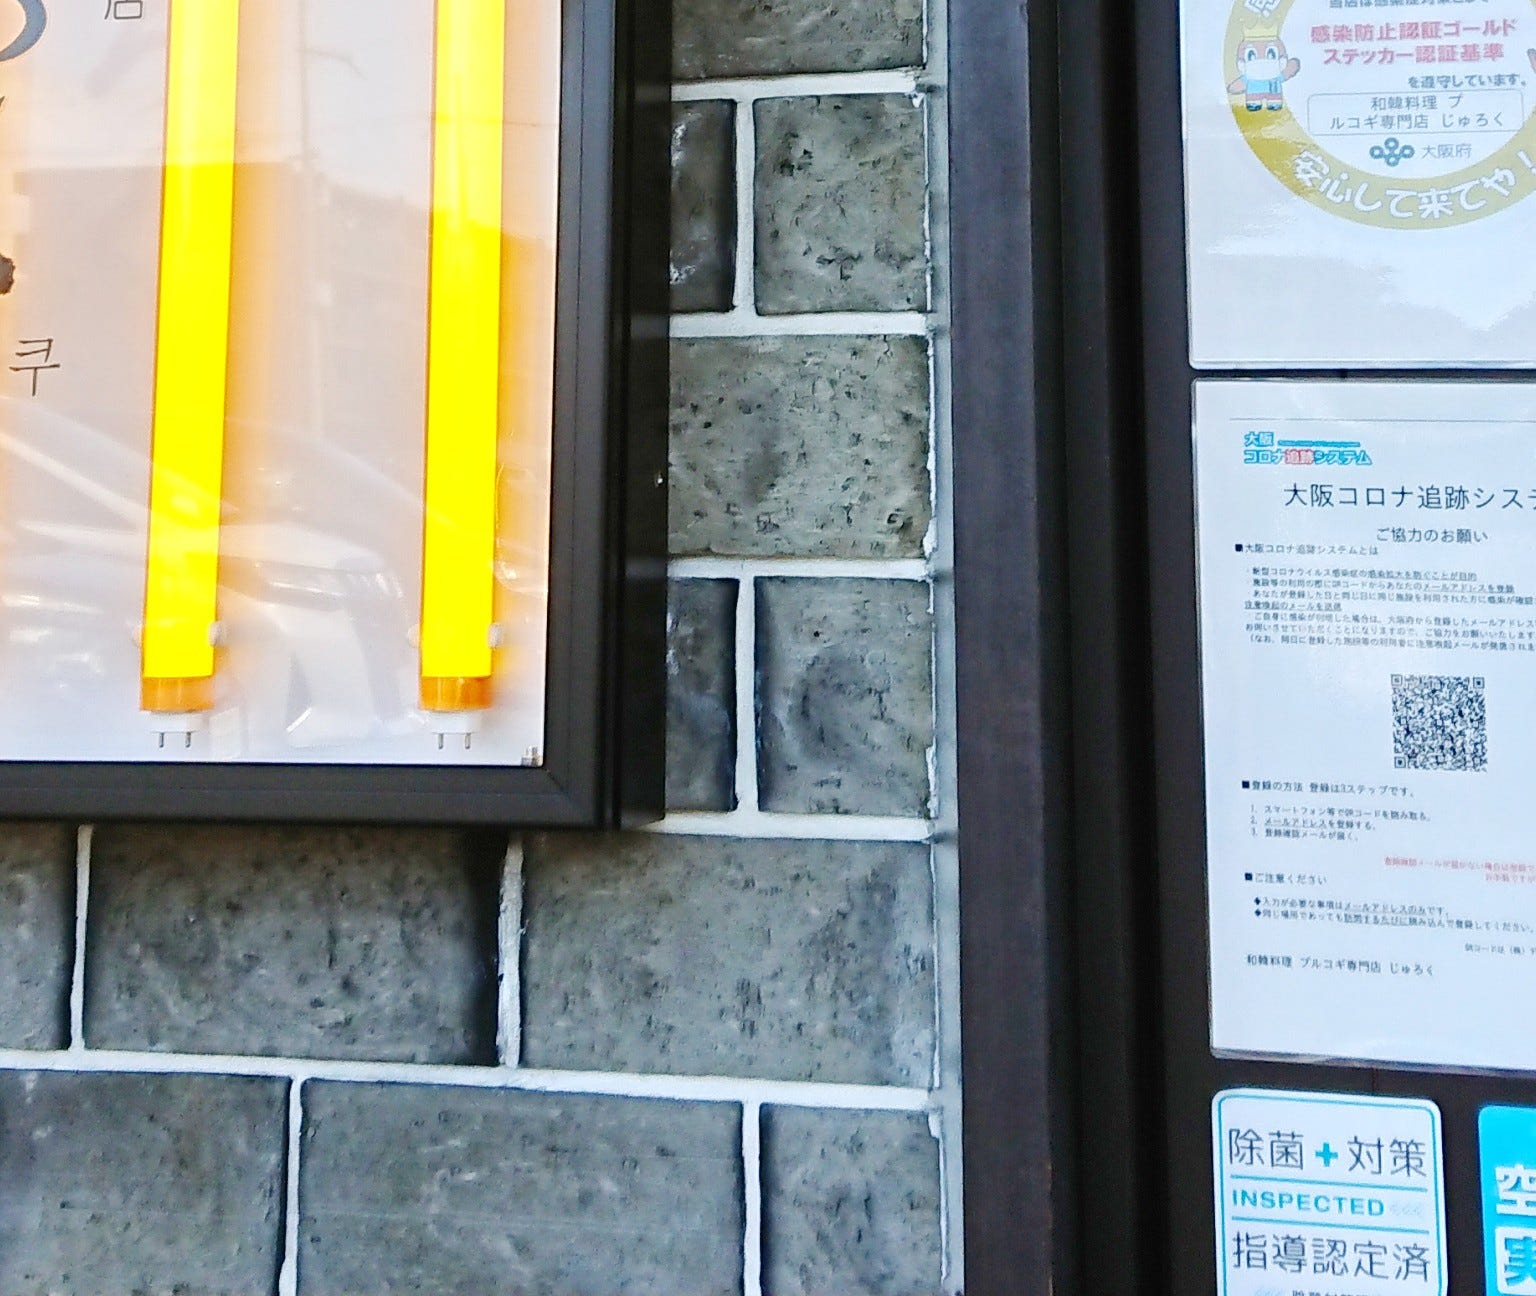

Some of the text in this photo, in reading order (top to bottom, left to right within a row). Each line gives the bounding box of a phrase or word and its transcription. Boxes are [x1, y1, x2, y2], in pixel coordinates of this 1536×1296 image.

[1309, 18, 1518, 45] 感染防止認証ゴールド
[1322, 42, 1506, 67] ステッカー認証基準
[1370, 94, 1439, 112] 和韓料理
[1329, 111, 1505, 131] ルコギ専門店 じゅろく
[1421, 143, 1473, 161] 大阪府
[1243, 430, 1275, 448] 大阪
[1243, 448, 1373, 466] コロナ追跡システム
[1375, 527, 1489, 545] ご協力のお願い
[1231, 1189, 1385, 1218] INSPECTED
[1230, 1230, 1431, 1284] 指導認定済
